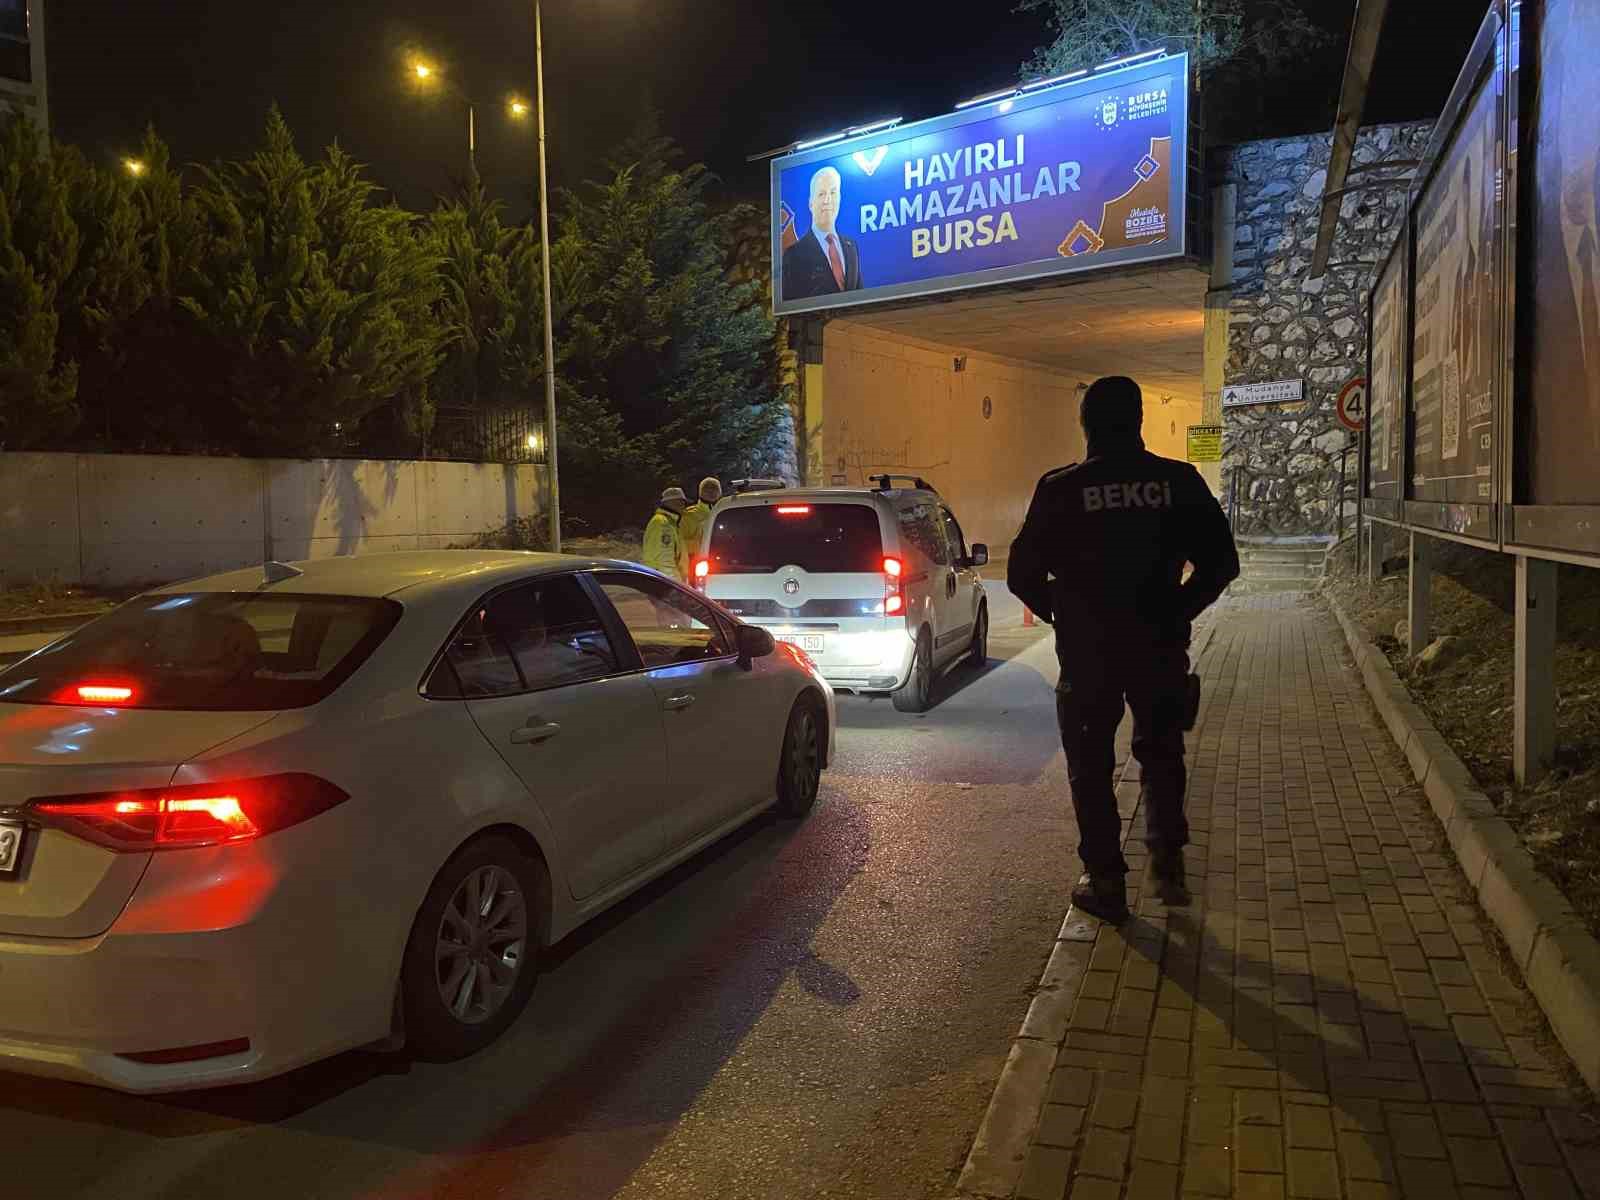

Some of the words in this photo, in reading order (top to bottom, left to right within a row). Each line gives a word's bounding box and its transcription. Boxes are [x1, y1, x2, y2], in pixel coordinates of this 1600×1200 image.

[1128, 88, 1167, 106] BURSA
[904, 134, 1025, 190] HAYIRLI
[859, 160, 1082, 234] RAMAZANLAR
[1125, 213, 1166, 228] BOZBEY
[911, 212, 1019, 258] BURSA
[1246, 384, 1291, 393] Mudanya
[1346, 392, 1364, 416] 4
[1083, 480, 1171, 511] BEKÇİ
